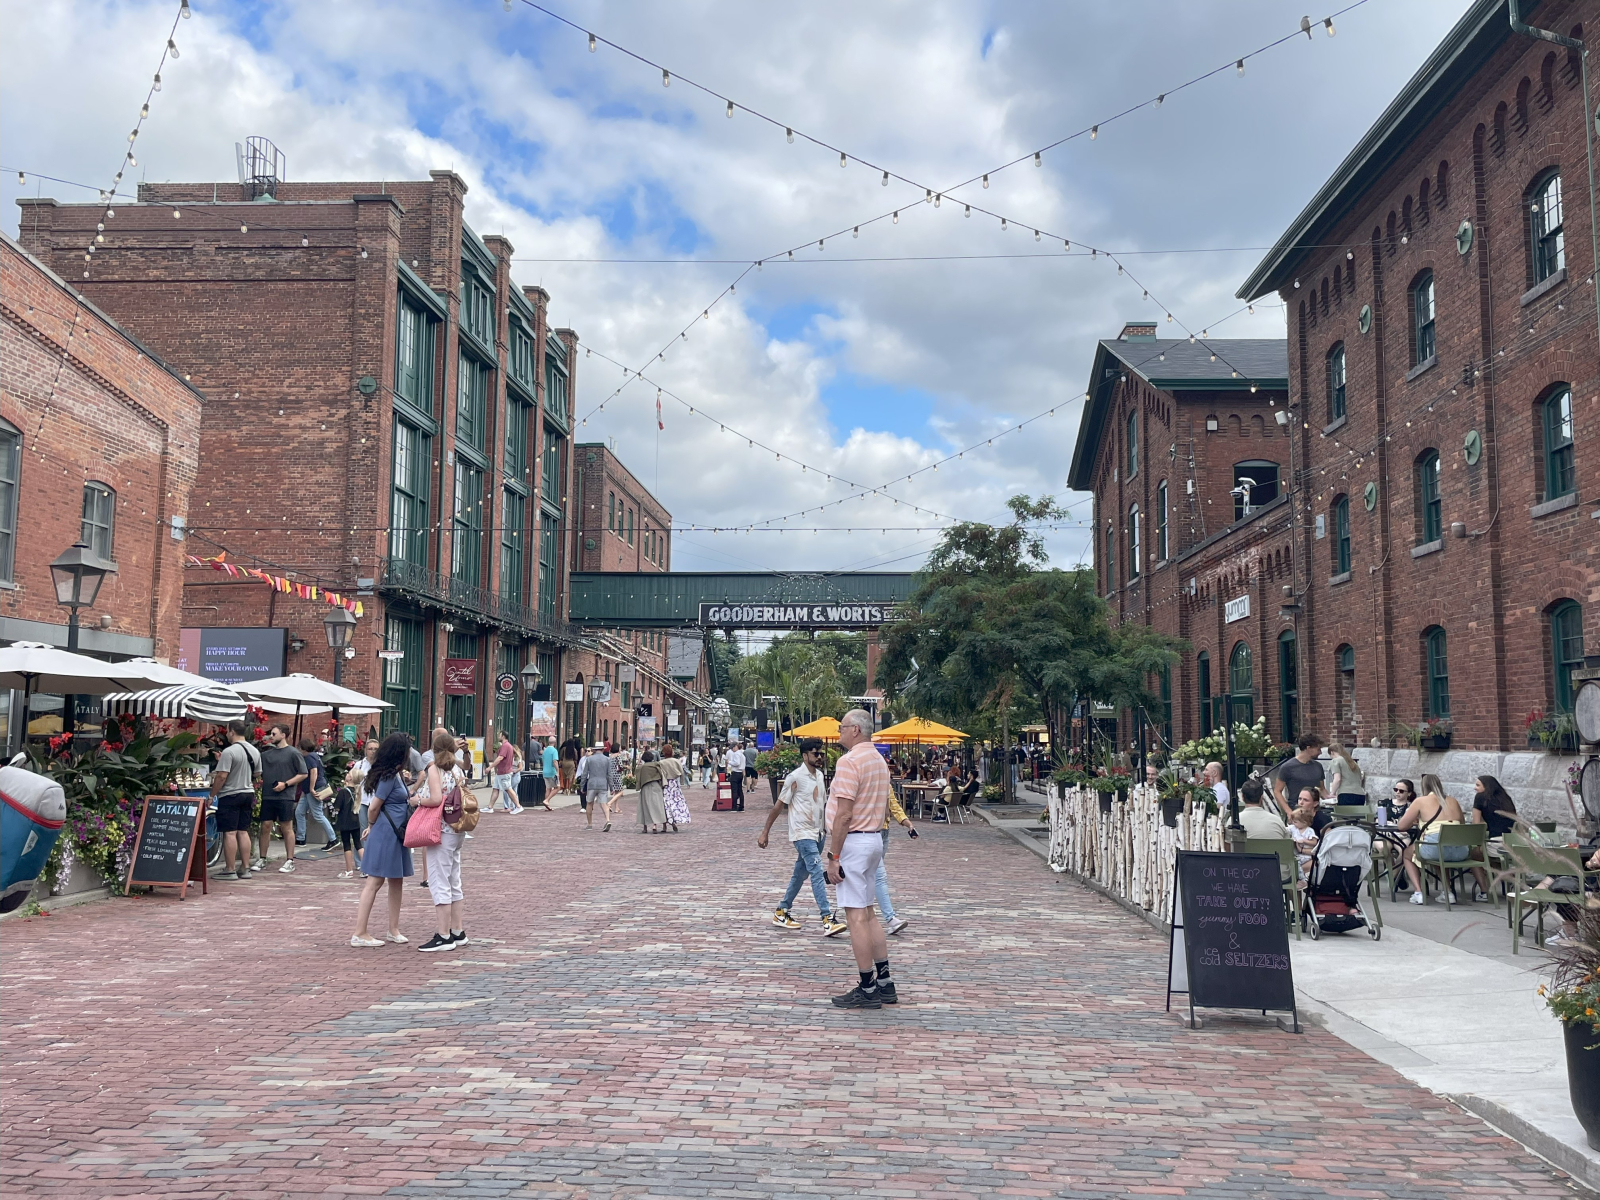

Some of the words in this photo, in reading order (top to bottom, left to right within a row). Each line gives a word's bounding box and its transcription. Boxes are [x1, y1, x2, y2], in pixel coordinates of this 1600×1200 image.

[709, 606, 810, 622] GOODERHAM
[812, 606, 826, 622] &
[826, 606, 882, 622] WORTS
[156, 804, 188, 815] EATALY
[1203, 868, 1216, 878] ON
[1221, 868, 1240, 878] THE
[1242, 868, 1260, 879] GO?
[1211, 883, 1224, 892] WE
[1228, 883, 1249, 894] HAVE
[1196, 895, 1227, 908] TAKE
[1233, 897, 1270, 910] OUT!!
[1198, 915, 1237, 931] yummy
[1238, 913, 1268, 926] FOOD
[1229, 932, 1240, 950] &
[1204, 948, 1219, 956] ice
[1200, 954, 1220, 966] cold
[1225, 952, 1289, 970] SELTZERS
